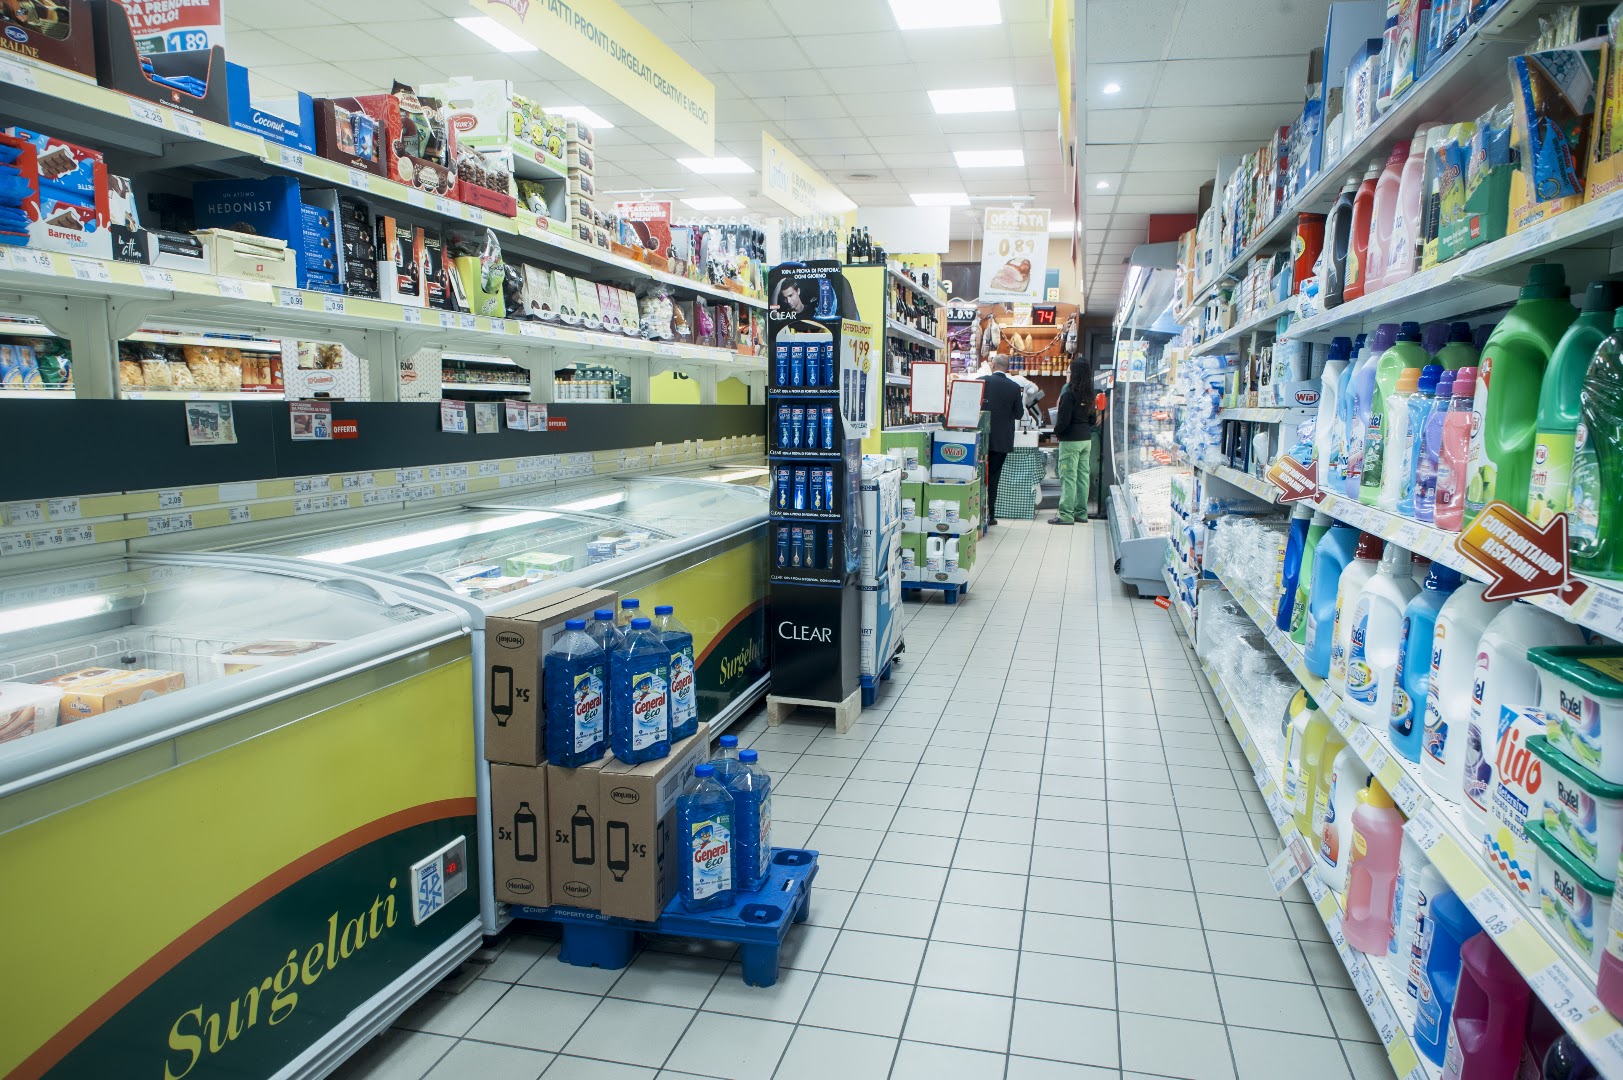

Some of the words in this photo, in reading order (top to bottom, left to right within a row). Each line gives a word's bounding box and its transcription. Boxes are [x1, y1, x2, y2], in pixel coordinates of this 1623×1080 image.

[143, 9, 179, 26] VOLO!
[535, 0, 572, 26] IATTI
[574, 13, 609, 52] PRONTI
[610, 39, 652, 85] SURGELATI
[653, 73, 682, 108] CREATIVI
[688, 99, 709, 126] VELOCI
[253, 112, 285, 132] Coconut
[1591, 183, 1596, 199] 3
[208, 201, 272, 213] HEDONIST
[990, 213, 1045, 227] OFFERTA
[48, 228, 82, 242] Barrette
[769, 310, 797, 320] CLEAR
[1037, 310, 1054, 323] 74
[1297, 394, 1317, 402] Wial
[944, 448, 963, 456] Wial
[1480, 514, 1562, 576] CONFRONTANDO
[778, 621, 832, 643] CLEAR
[499, 636, 521, 645] Henkel
[672, 672, 693, 693] General
[516, 688, 530, 702] 5x
[635, 692, 666, 714] General
[576, 692, 602, 716] General
[613, 791, 638, 801] Henkel
[498, 827, 512, 842] 5x
[555, 829, 569, 844] 5x
[1502, 815, 1529, 843] lavatrice
[632, 843, 646, 857] 5x
[694, 841, 729, 863] General
[508, 882, 532, 890] Henkel
[1554, 869, 1575, 903] Rixel
[554, 909, 586, 918] PROPERTY
[1485, 914, 1508, 935] 0,89
[164, 877, 399, 1080] Surgelati
[1553, 998, 1583, 1024] 3,59
[1380, 1023, 1394, 1044] 0,95
